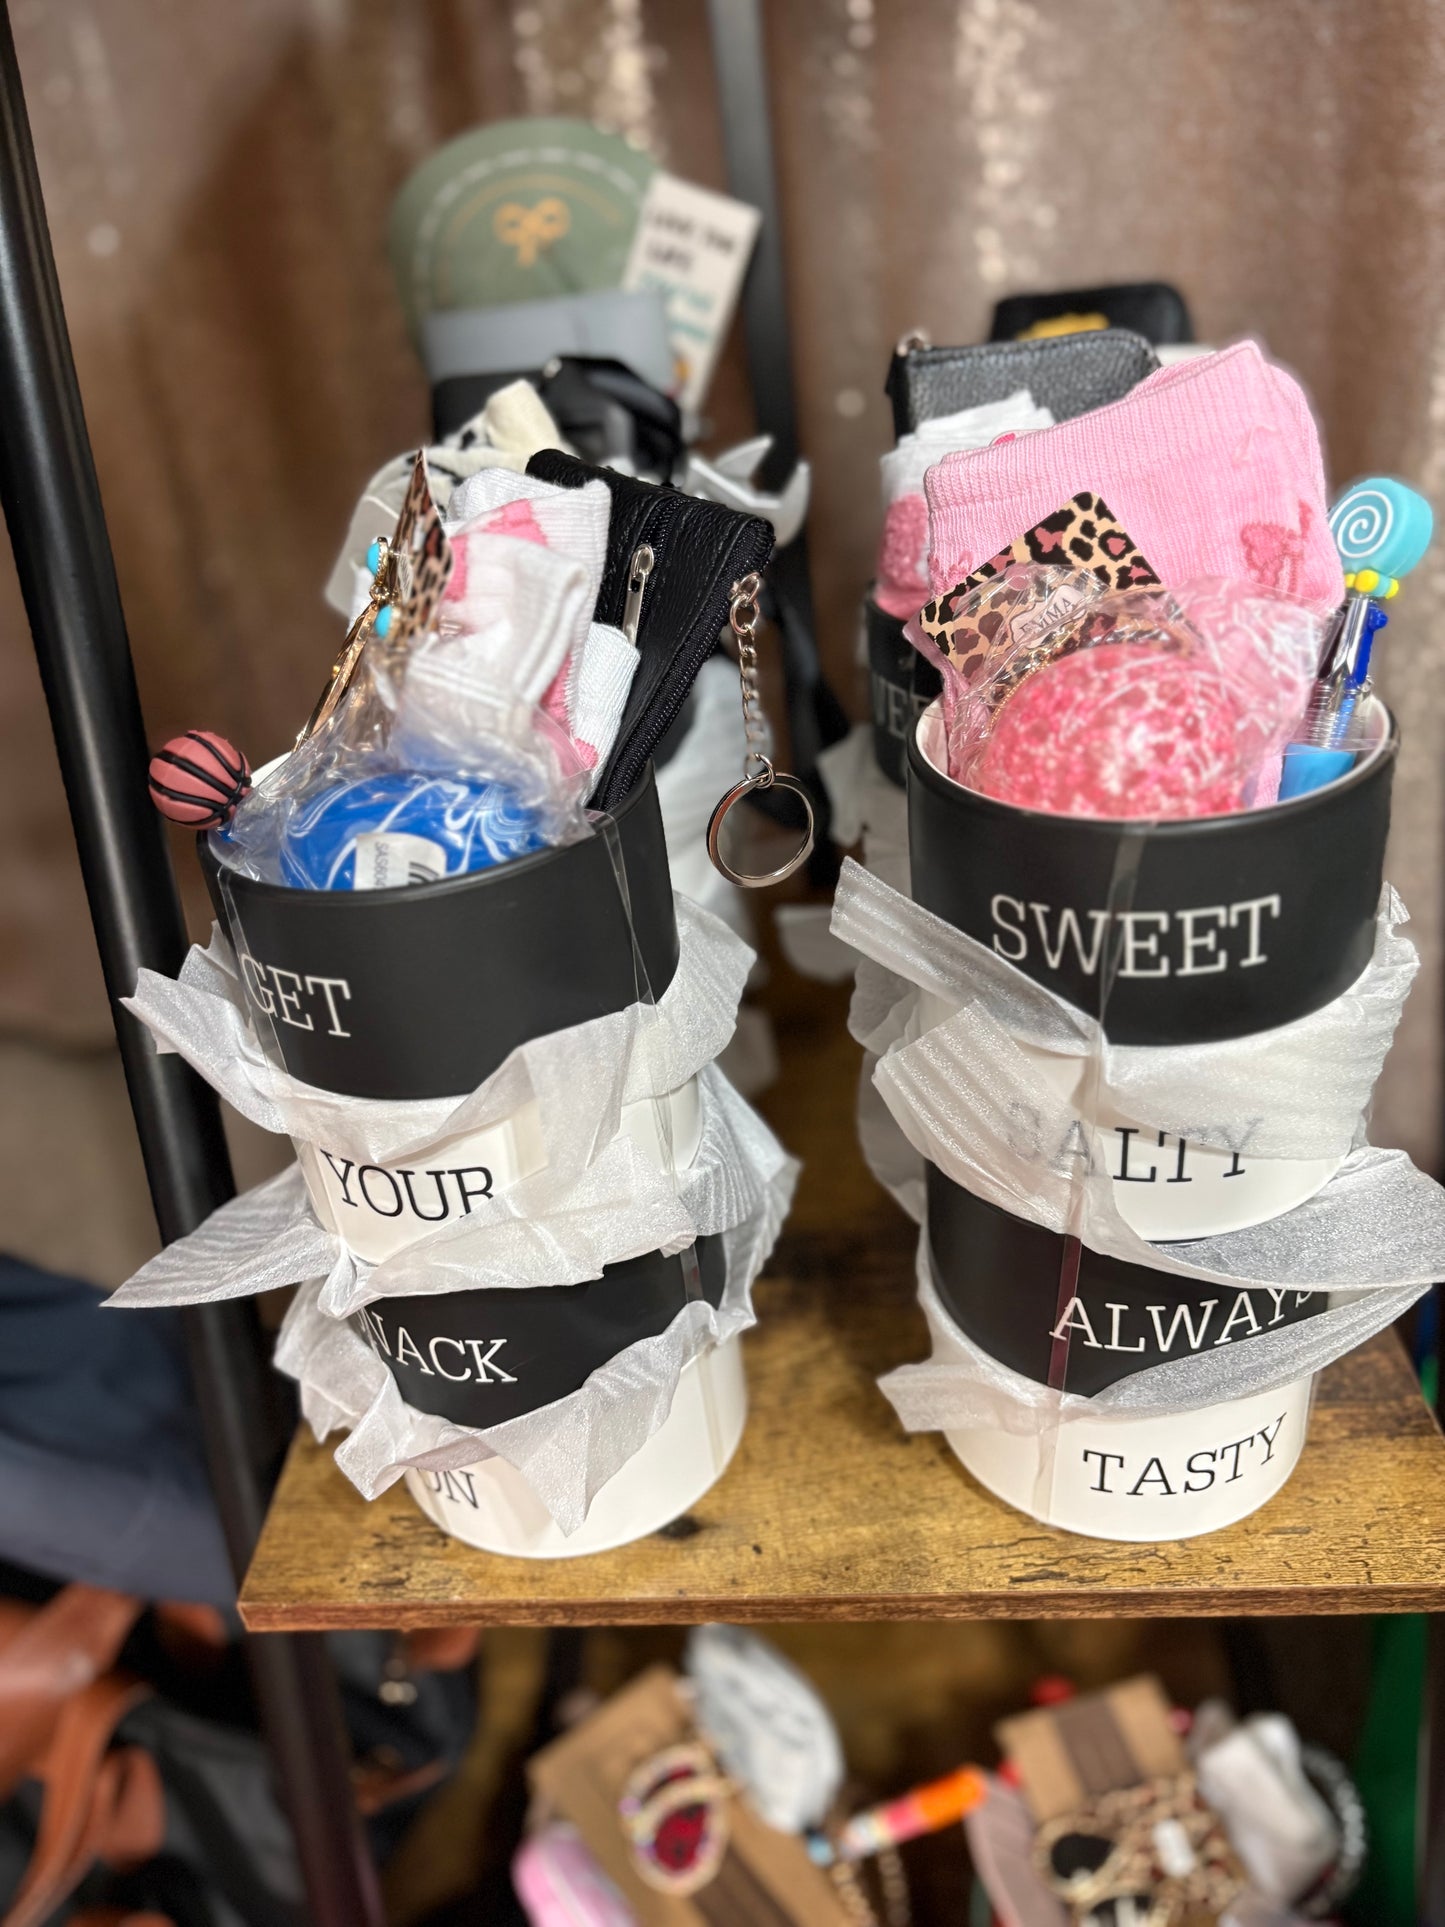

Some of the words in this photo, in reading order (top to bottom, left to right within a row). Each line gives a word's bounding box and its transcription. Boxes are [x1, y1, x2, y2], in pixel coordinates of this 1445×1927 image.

[991, 894, 1280, 977] SWEET
[241, 953, 351, 1037] GET
[320, 1149, 494, 1221] YOUR
[357, 1307, 518, 1383] NACK
[1083, 1412, 1287, 1496] TASTY
